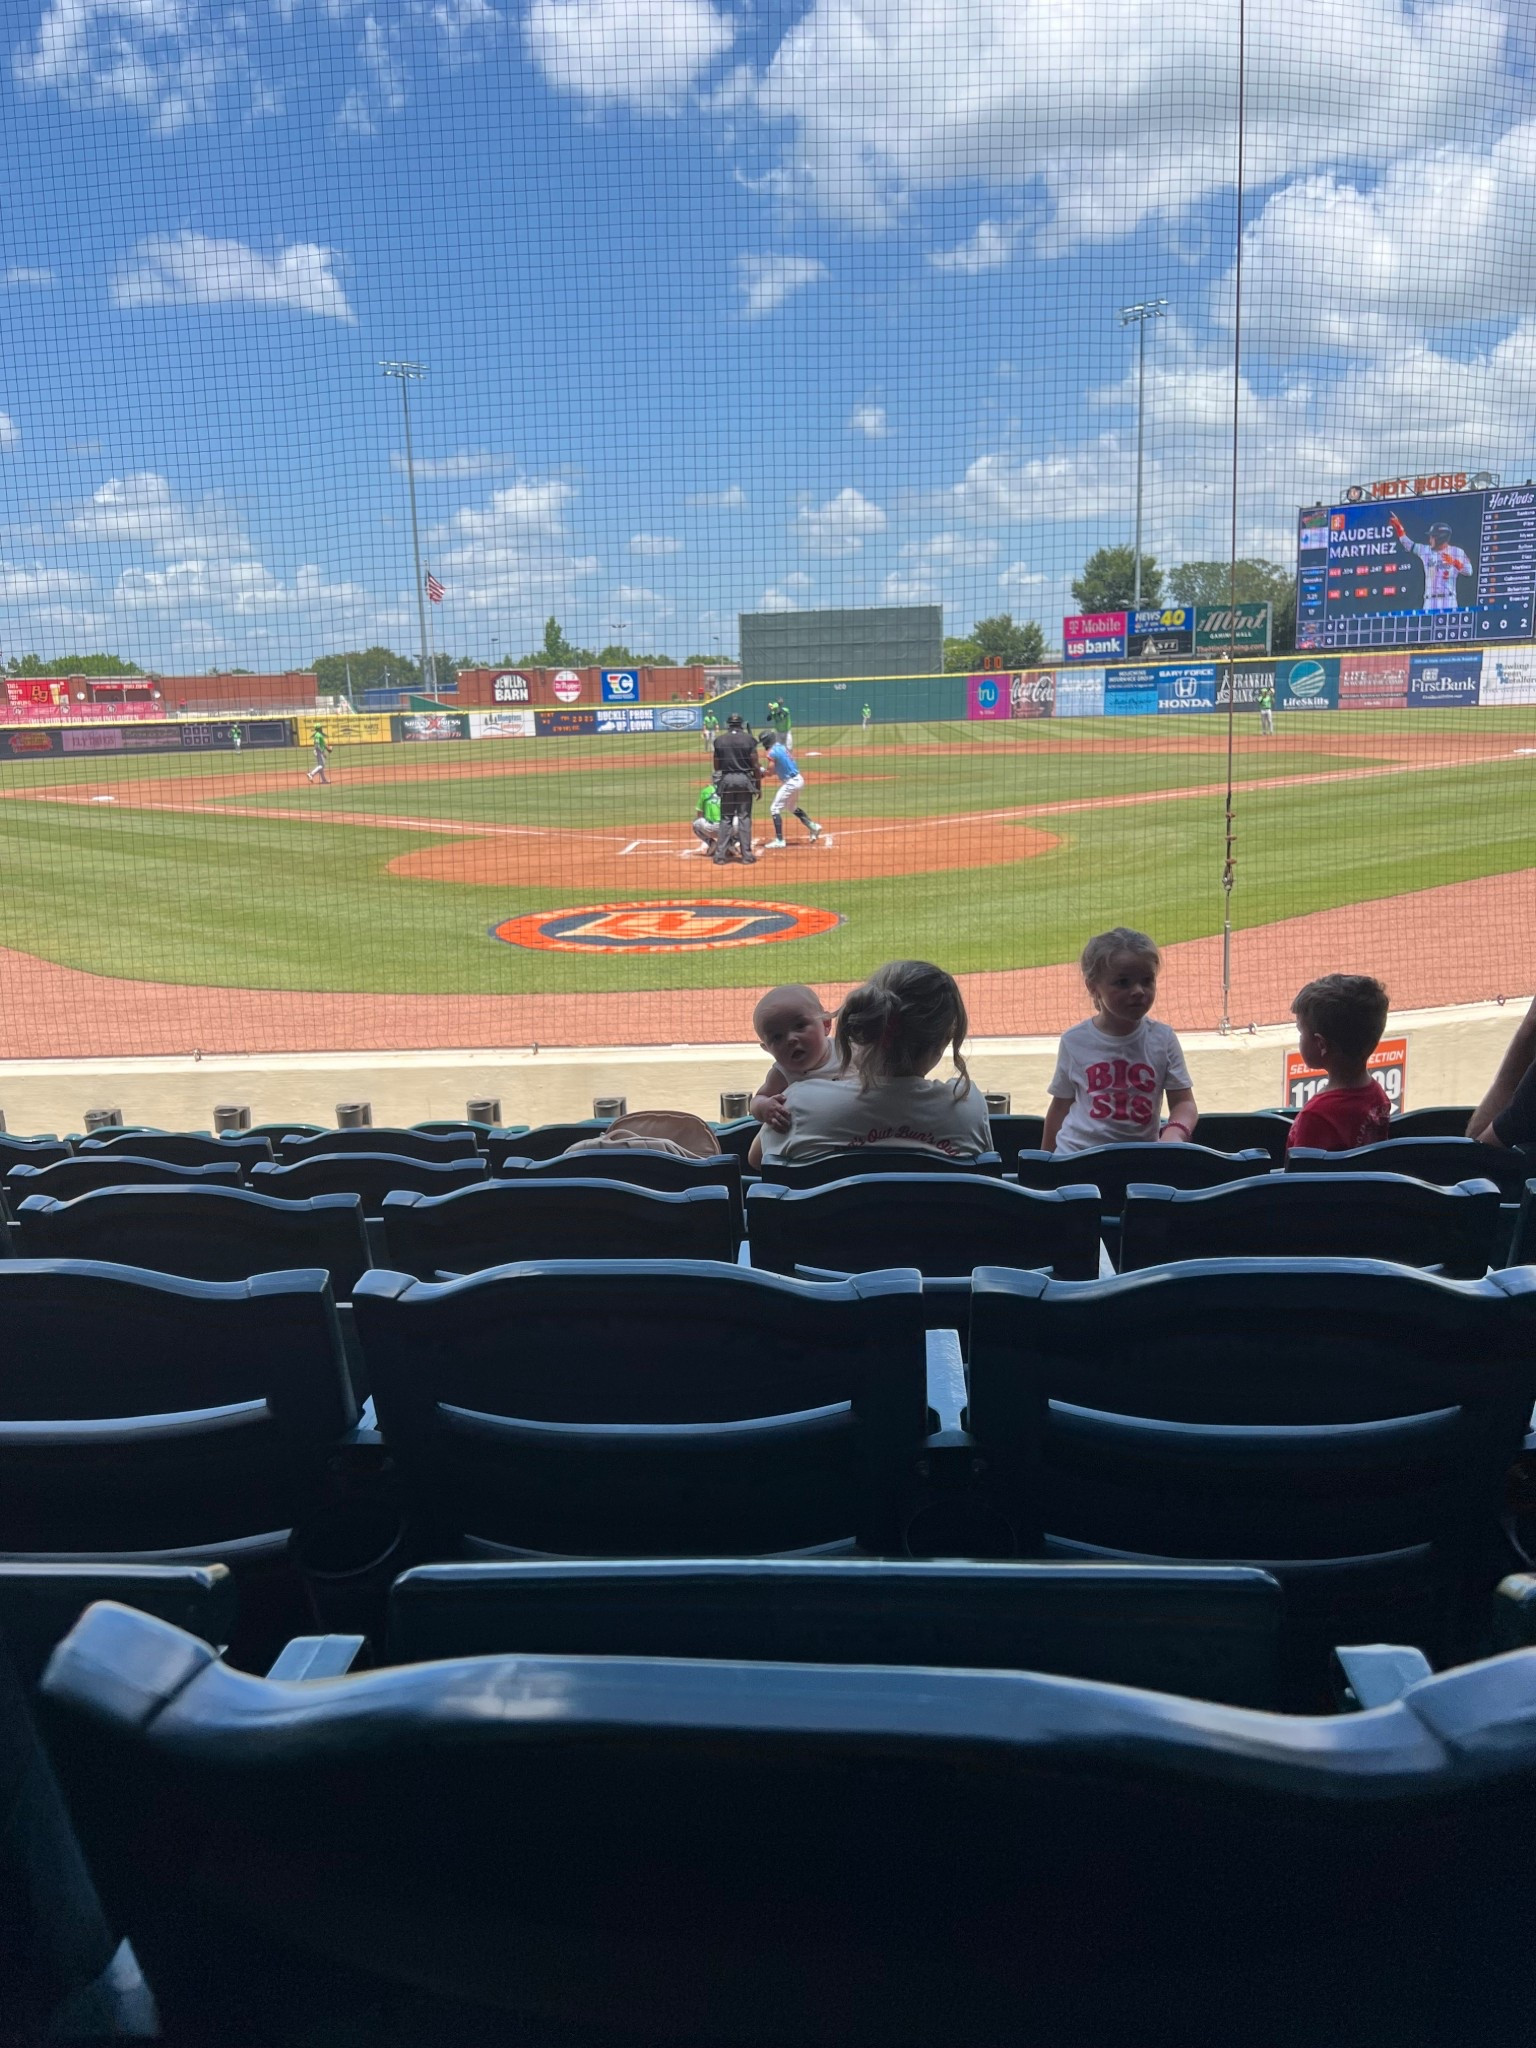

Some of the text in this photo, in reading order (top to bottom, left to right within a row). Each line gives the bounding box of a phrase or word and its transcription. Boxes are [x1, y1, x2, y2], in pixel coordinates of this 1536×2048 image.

[1372, 472, 1466, 496] HOT RODS
[1489, 491, 1534, 509] Hot Rods
[1330, 526, 1394, 543] RAUDELIS
[1330, 542, 1397, 559] MARTINEZ
[1082, 618, 1121, 633] Mobile
[1135, 609, 1186, 626] NEWS 40
[1197, 608, 1267, 632] Mint
[1482, 618, 1528, 630] 0 0 2
[495, 675, 527, 688] JEWELRY
[1232, 673, 1276, 689] FRANKLIN
[1411, 677, 1476, 693] FirstBank
[495, 688, 529, 702] BARN
[1232, 689, 1255, 703] BANK
[1283, 697, 1330, 707] LifeSkills
[1158, 699, 1213, 708] HONDA
[596, 710, 626, 721] BUCKLE
[629, 709, 654, 720] PHONE
[1367, 1050, 1404, 1065] ECTION
[1085, 1059, 1156, 1095] BIG
[1088, 1092, 1153, 1126] SIS
[867, 1127, 893, 1143] Out
[894, 1125, 936, 1145] Bun's
